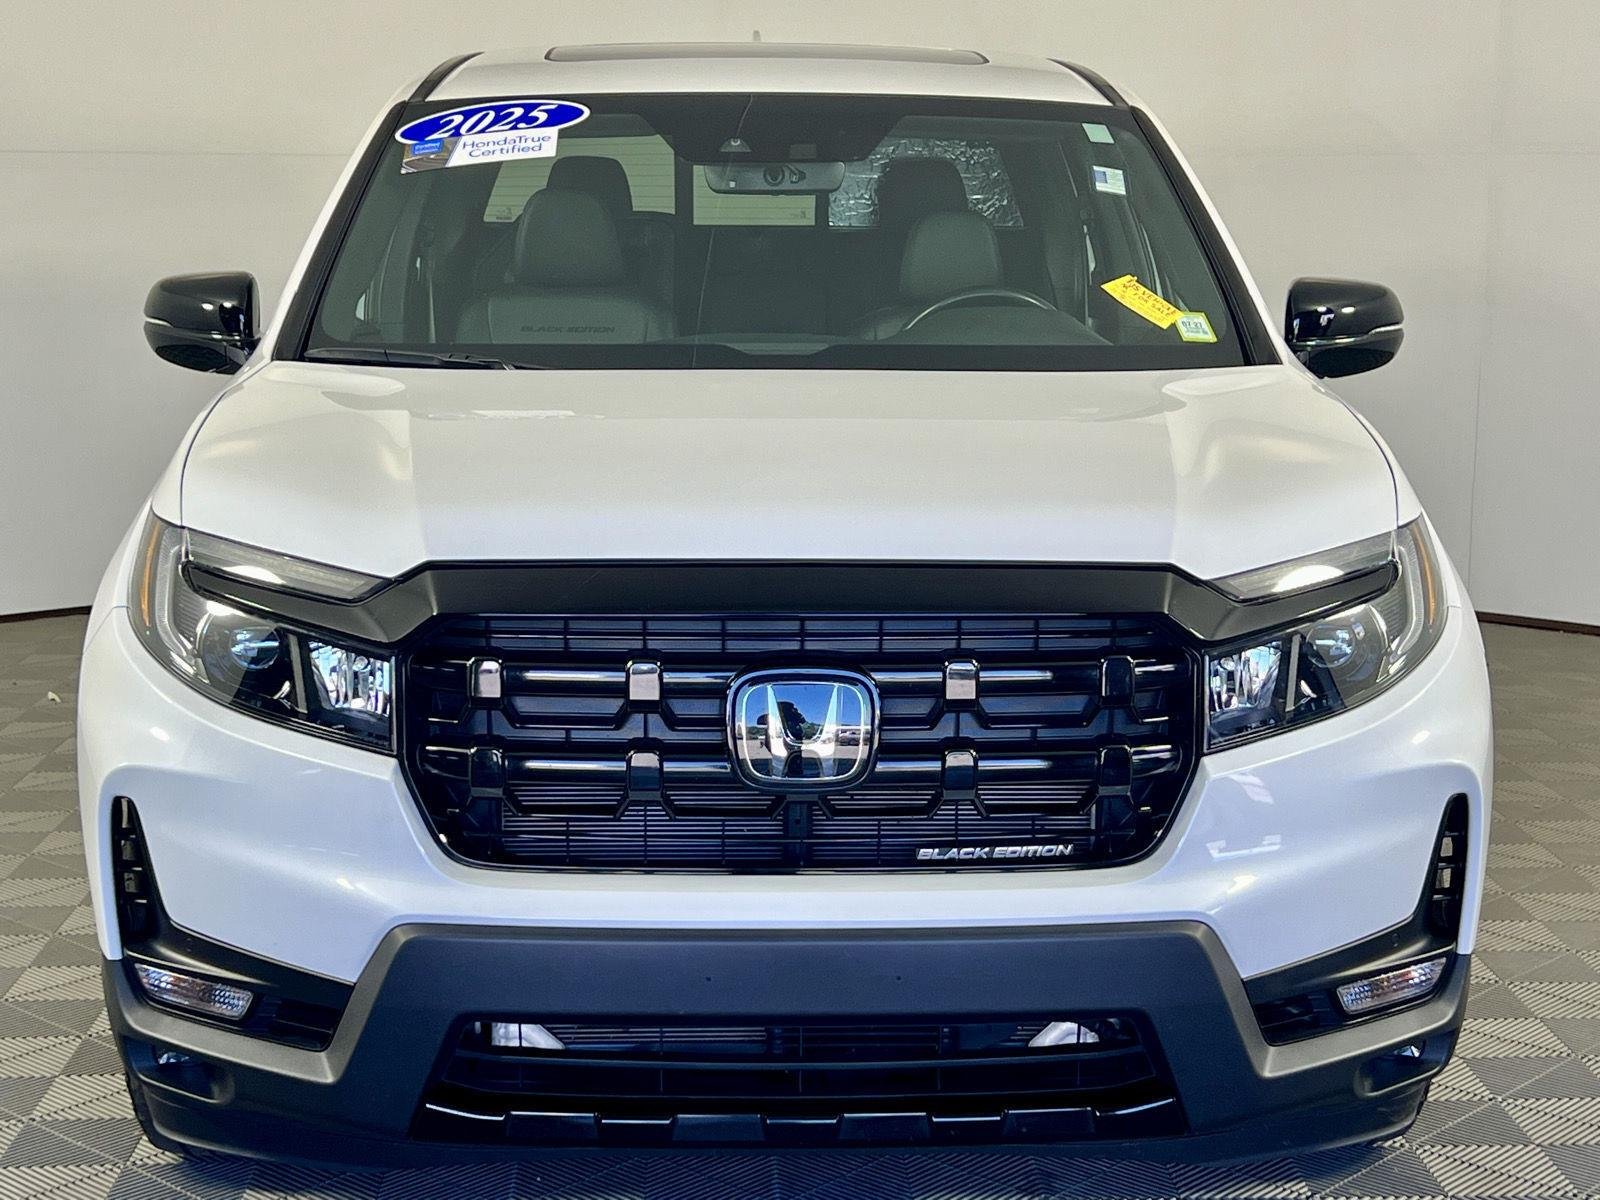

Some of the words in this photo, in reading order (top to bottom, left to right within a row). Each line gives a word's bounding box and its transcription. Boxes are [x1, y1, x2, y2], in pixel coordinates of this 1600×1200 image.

[424, 104, 559, 141] 2025
[462, 134, 552, 150] HondaTrue
[468, 142, 543, 158] Certified
[917, 848, 989, 860] BLACK
[992, 844, 1074, 858] EDITION
